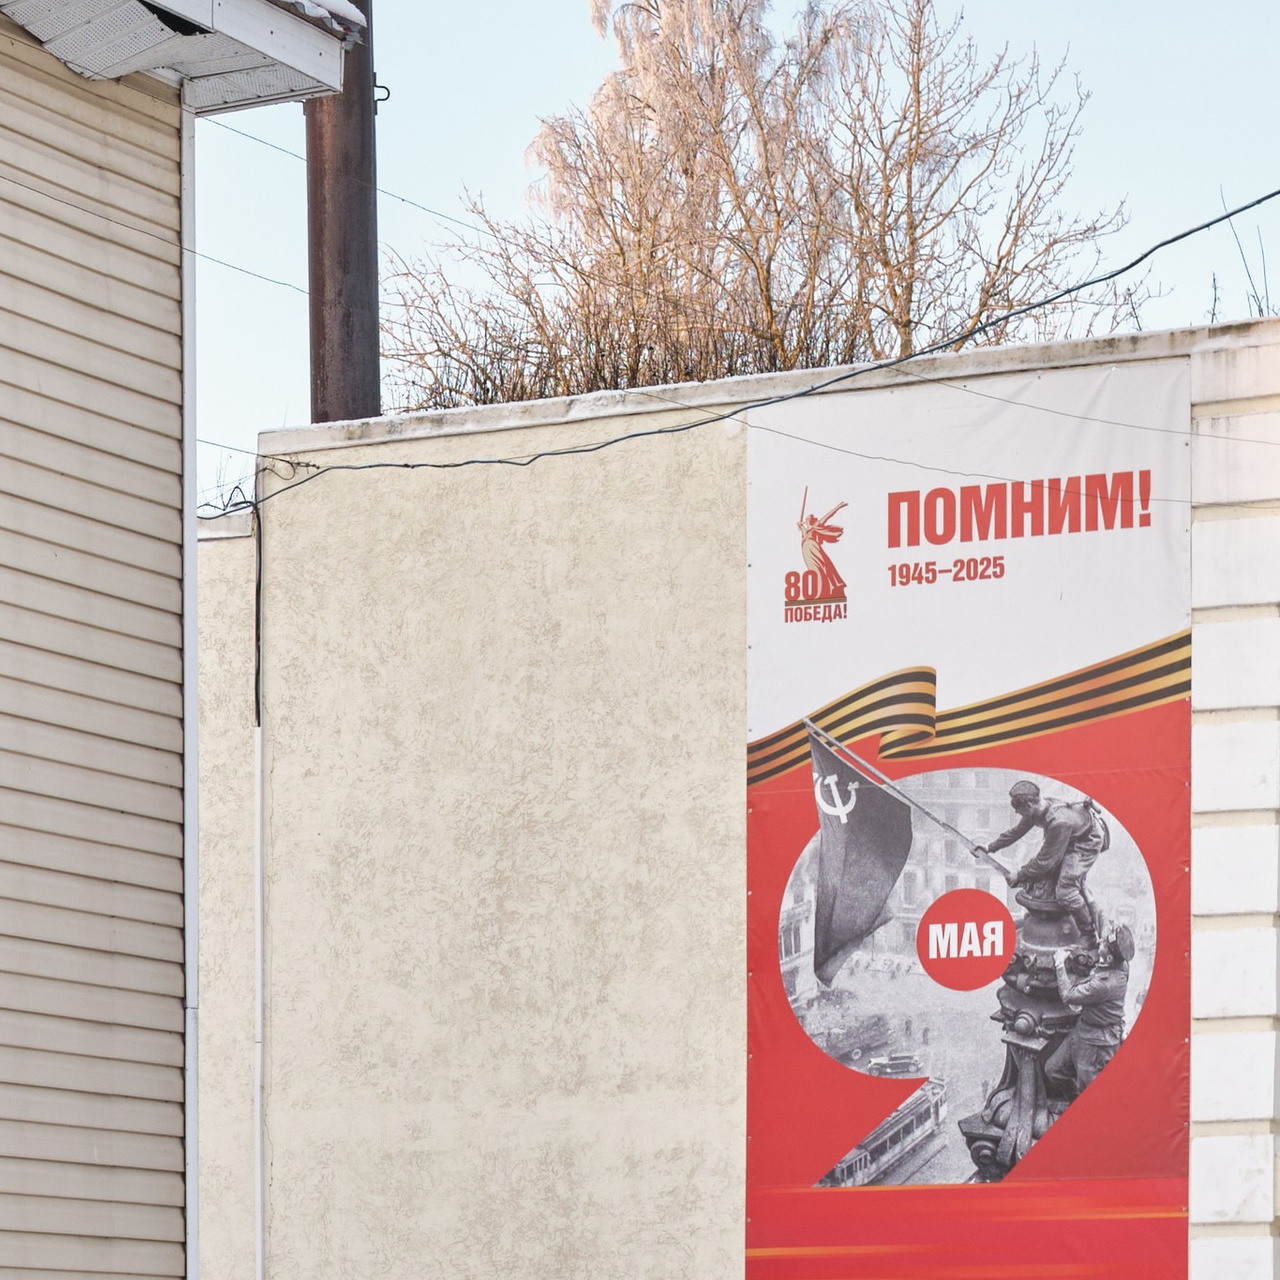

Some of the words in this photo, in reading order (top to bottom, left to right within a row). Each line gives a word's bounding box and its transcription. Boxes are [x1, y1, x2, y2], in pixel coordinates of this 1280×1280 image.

[887, 469, 1152, 549] ПОМНИМ!
[784, 569, 819, 602] 80
[784, 603, 848, 624] ПОБЕДА!
[928, 920, 1004, 960] МАЯ
